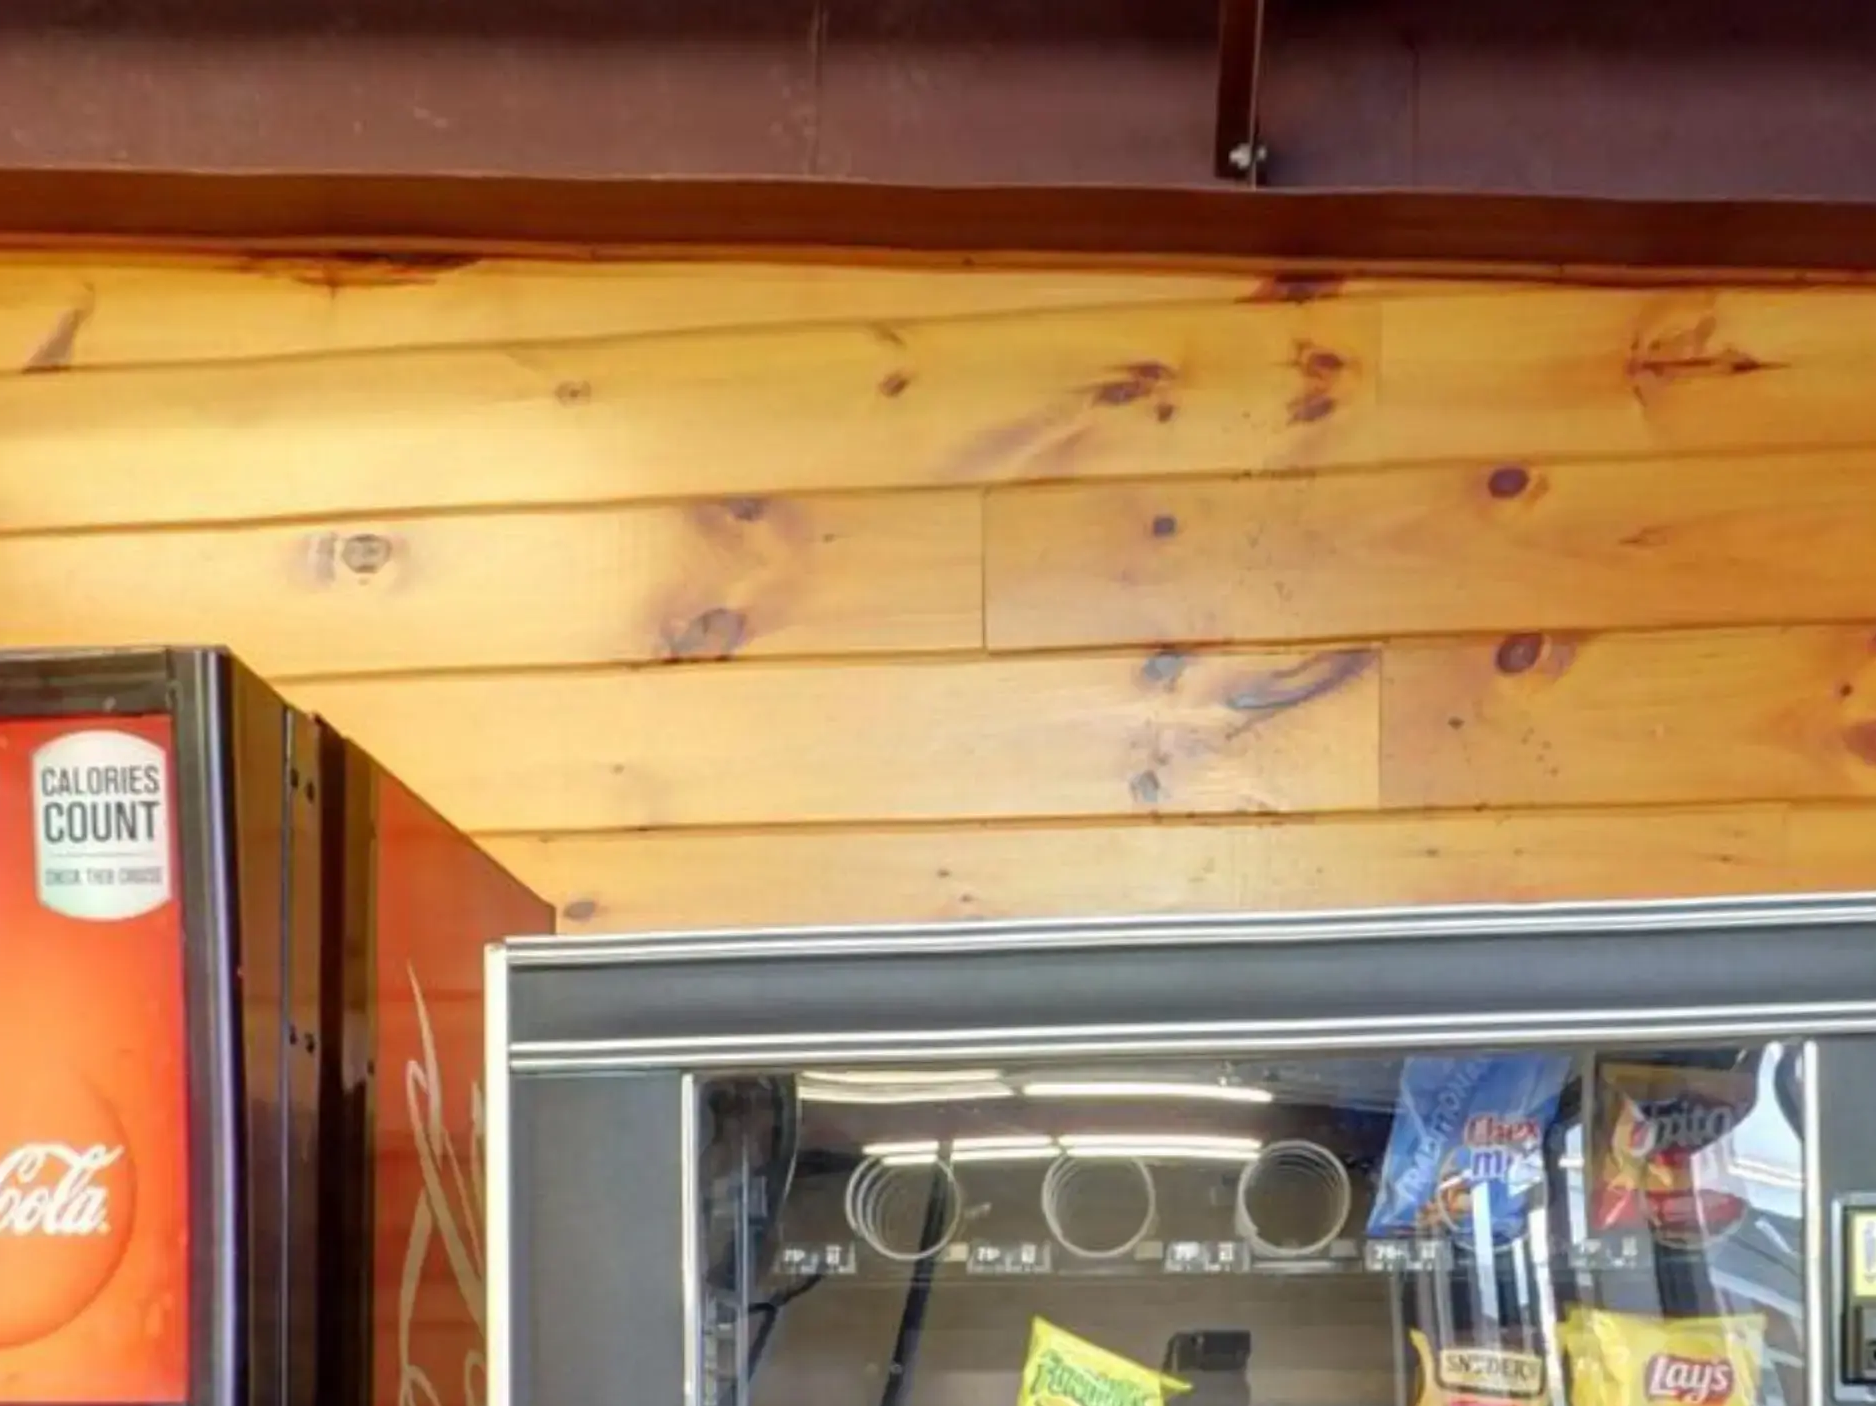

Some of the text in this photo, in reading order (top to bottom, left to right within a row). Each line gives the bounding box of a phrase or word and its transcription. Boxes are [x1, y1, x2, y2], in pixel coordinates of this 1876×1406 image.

[41, 765, 161, 796] CALORIES
[44, 801, 161, 843] COUNT
[1647, 1356, 1733, 1401] Lay's
